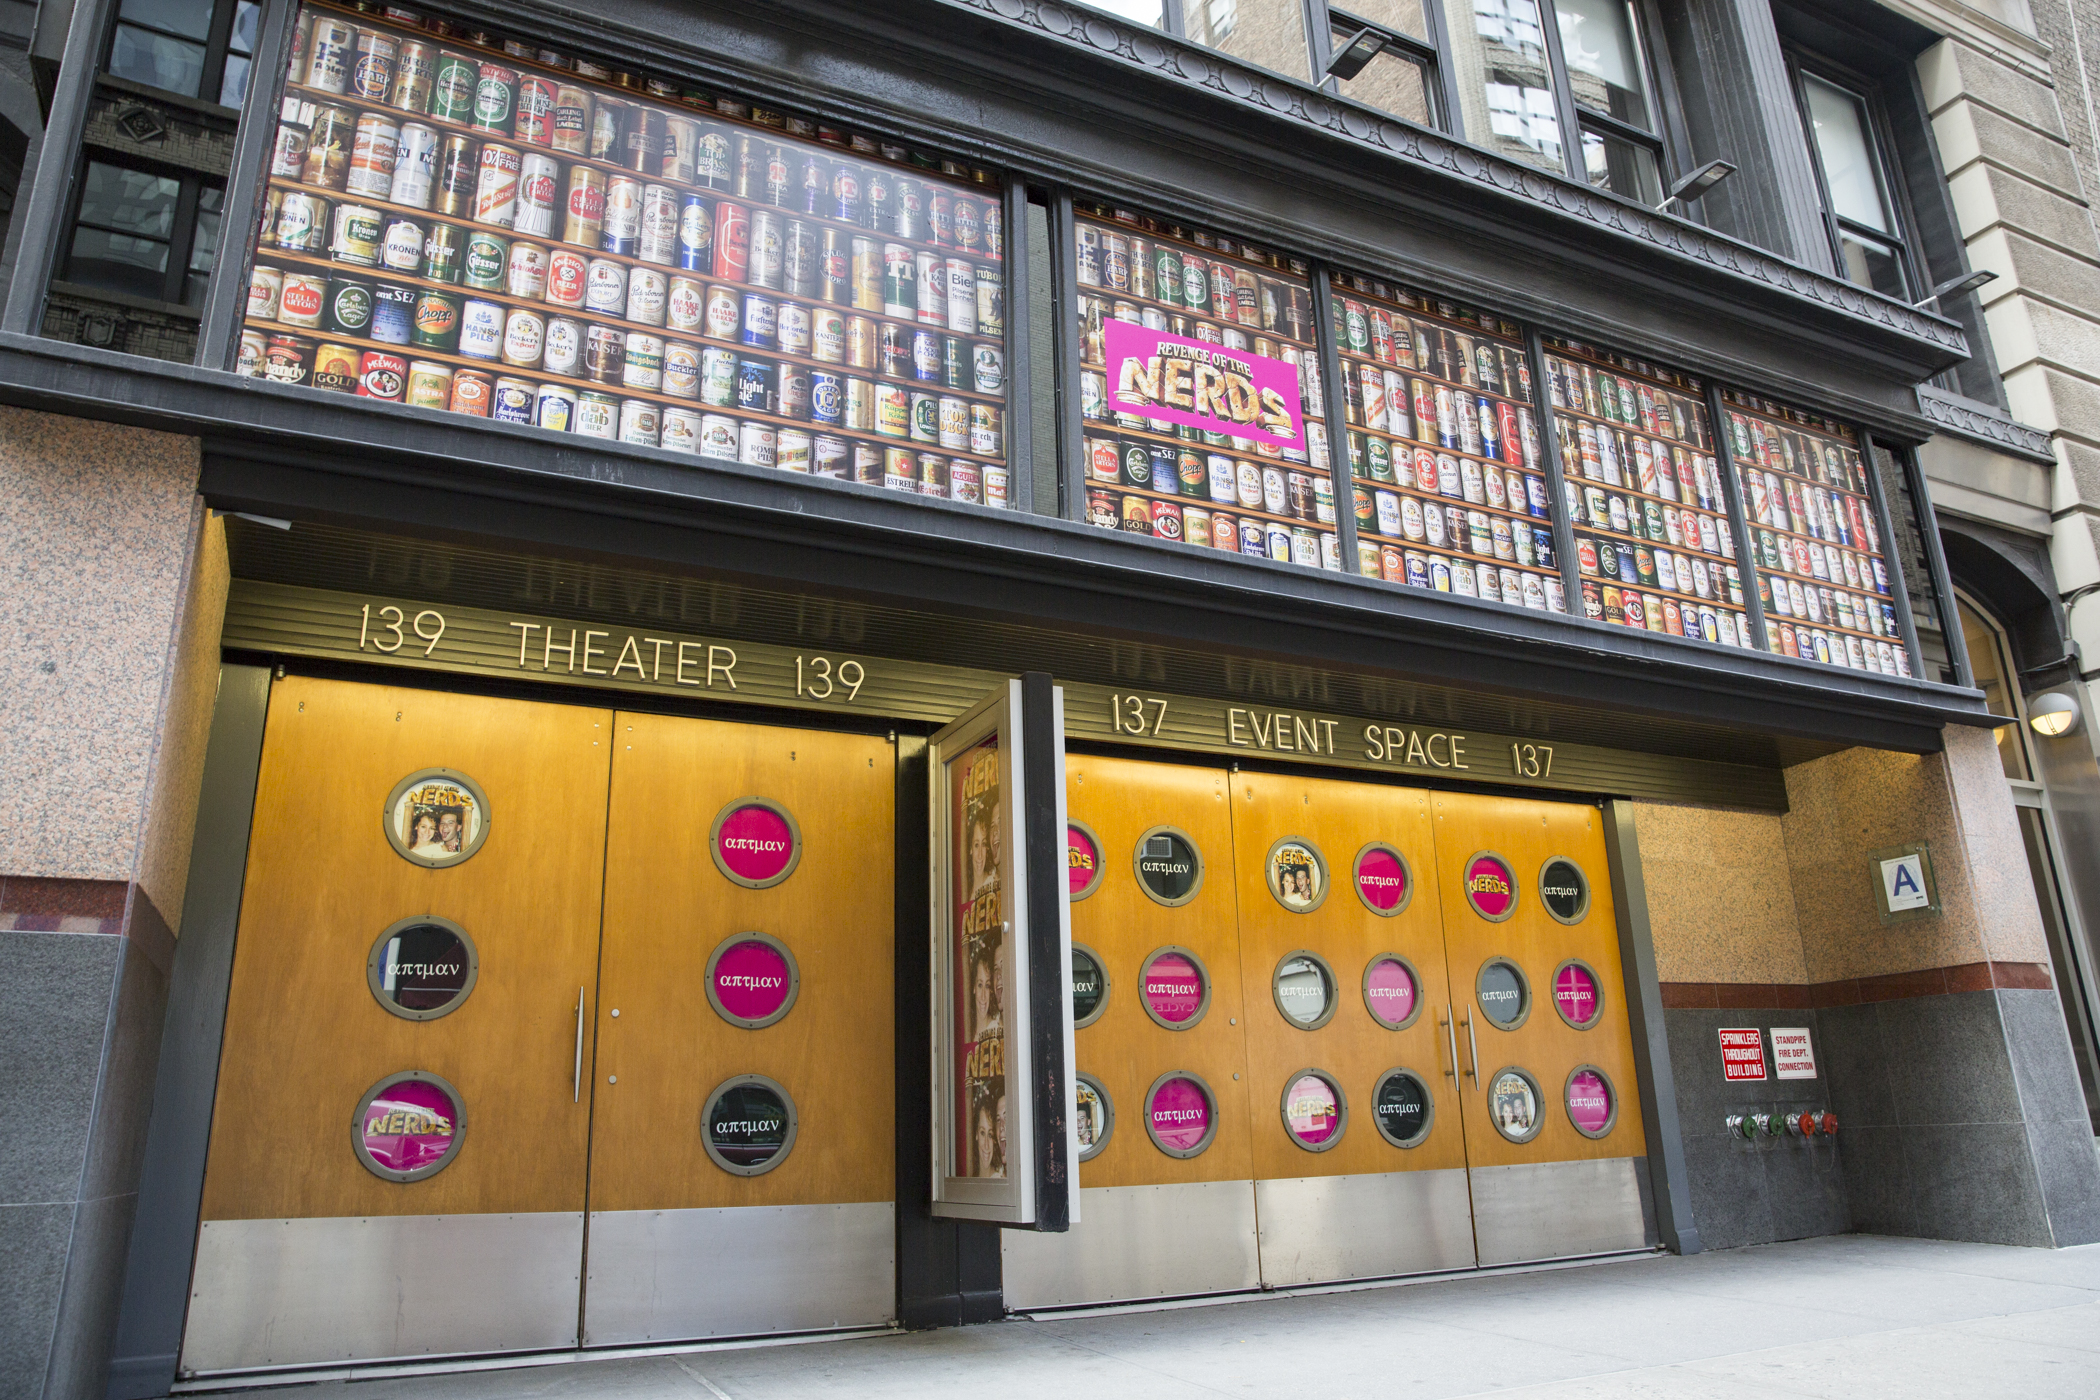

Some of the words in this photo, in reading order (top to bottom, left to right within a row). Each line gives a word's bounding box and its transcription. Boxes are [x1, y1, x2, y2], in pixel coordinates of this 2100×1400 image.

[499, 158, 521, 172] FREE
[352, 223, 378, 236] Kronen
[388, 242, 421, 256] KRONEN
[468, 252, 500, 271] Gösser
[553, 256, 585, 273] ANCHOR
[555, 280, 578, 291] BEER
[951, 273, 975, 289] Bier
[285, 298, 317, 310] ARTOIS
[286, 291, 318, 303] STELLA
[337, 297, 369, 311] Carlsberg
[673, 297, 700, 311] HAAKE
[343, 309, 365, 323] Lager
[417, 304, 453, 323] Chopp
[675, 305, 697, 318] BECK
[712, 307, 738, 318] HAAKE
[715, 314, 735, 323] BECK
[465, 323, 500, 337] HANSA
[469, 332, 494, 344] PILS
[509, 333, 539, 345] Becker's
[510, 339, 537, 350] Export
[588, 340, 624, 357] KAISER
[1156, 342, 1210, 364] REVENGE
[1212, 353, 1227, 368] OF
[1227, 357, 1253, 376] THE
[666, 363, 698, 376] Buckler
[317, 373, 356, 388] GOLD
[739, 377, 765, 394] Light
[414, 387, 446, 398] ASTRA
[738, 389, 753, 402] ale
[1114, 356, 1297, 440] NERDS
[580, 411, 610, 426] dab
[941, 408, 967, 423] TOP
[584, 422, 603, 432] BIER
[940, 420, 970, 436] DECK
[1094, 453, 1116, 464] STELLA
[1179, 460, 1203, 476] Chopp
[1211, 474, 1235, 486] HANSA
[1215, 481, 1232, 491] PILS
[1126, 520, 1153, 532] GOLD
[1296, 543, 1315, 556] dab
[359, 604, 446, 657] 139
[510, 621, 738, 690] THEATER
[794, 655, 865, 701] 139
[1112, 693, 1168, 737] 137
[1227, 707, 1339, 755] EVENT
[1363, 724, 1470, 769] SPACE
[1511, 742, 1554, 778] 137
[406, 788, 474, 807] NERDS
[725, 836, 785, 854] απτμαν
[1273, 851, 1314, 865] NERDS
[1142, 859, 1190, 875] απτμαν
[1359, 873, 1400, 888] απτμαν
[1468, 878, 1510, 895] NERDS
[1893, 864, 1919, 896] A
[1543, 884, 1578, 899] απτμαν
[387, 960, 460, 980] απτμαν
[719, 972, 782, 991] απτμαν
[1147, 983, 1196, 998] απτμαν
[1369, 985, 1410, 1000] απτμαν
[1482, 989, 1519, 1003] απτμαν
[1557, 989, 1592, 1003] απτμαν
[1721, 1033, 1759, 1046] SPRINKLERS
[1775, 1035, 1807, 1045] STANDPIPE
[1724, 1048, 1761, 1061] THROUGHOUT
[1778, 1049, 1791, 1058] FIRE
[1792, 1048, 1809, 1058] DEPT.
[1727, 1063, 1763, 1077] BUILDING
[1778, 1062, 1814, 1072] CONNECTION
[1287, 1099, 1336, 1118] NERDS
[1379, 1102, 1421, 1116] απτμαν
[1569, 1096, 1605, 1110] απτμαν
[1153, 1107, 1203, 1124] απτμαν
[366, 1112, 452, 1136] NERDS
[716, 1117, 779, 1136] απτμαν
